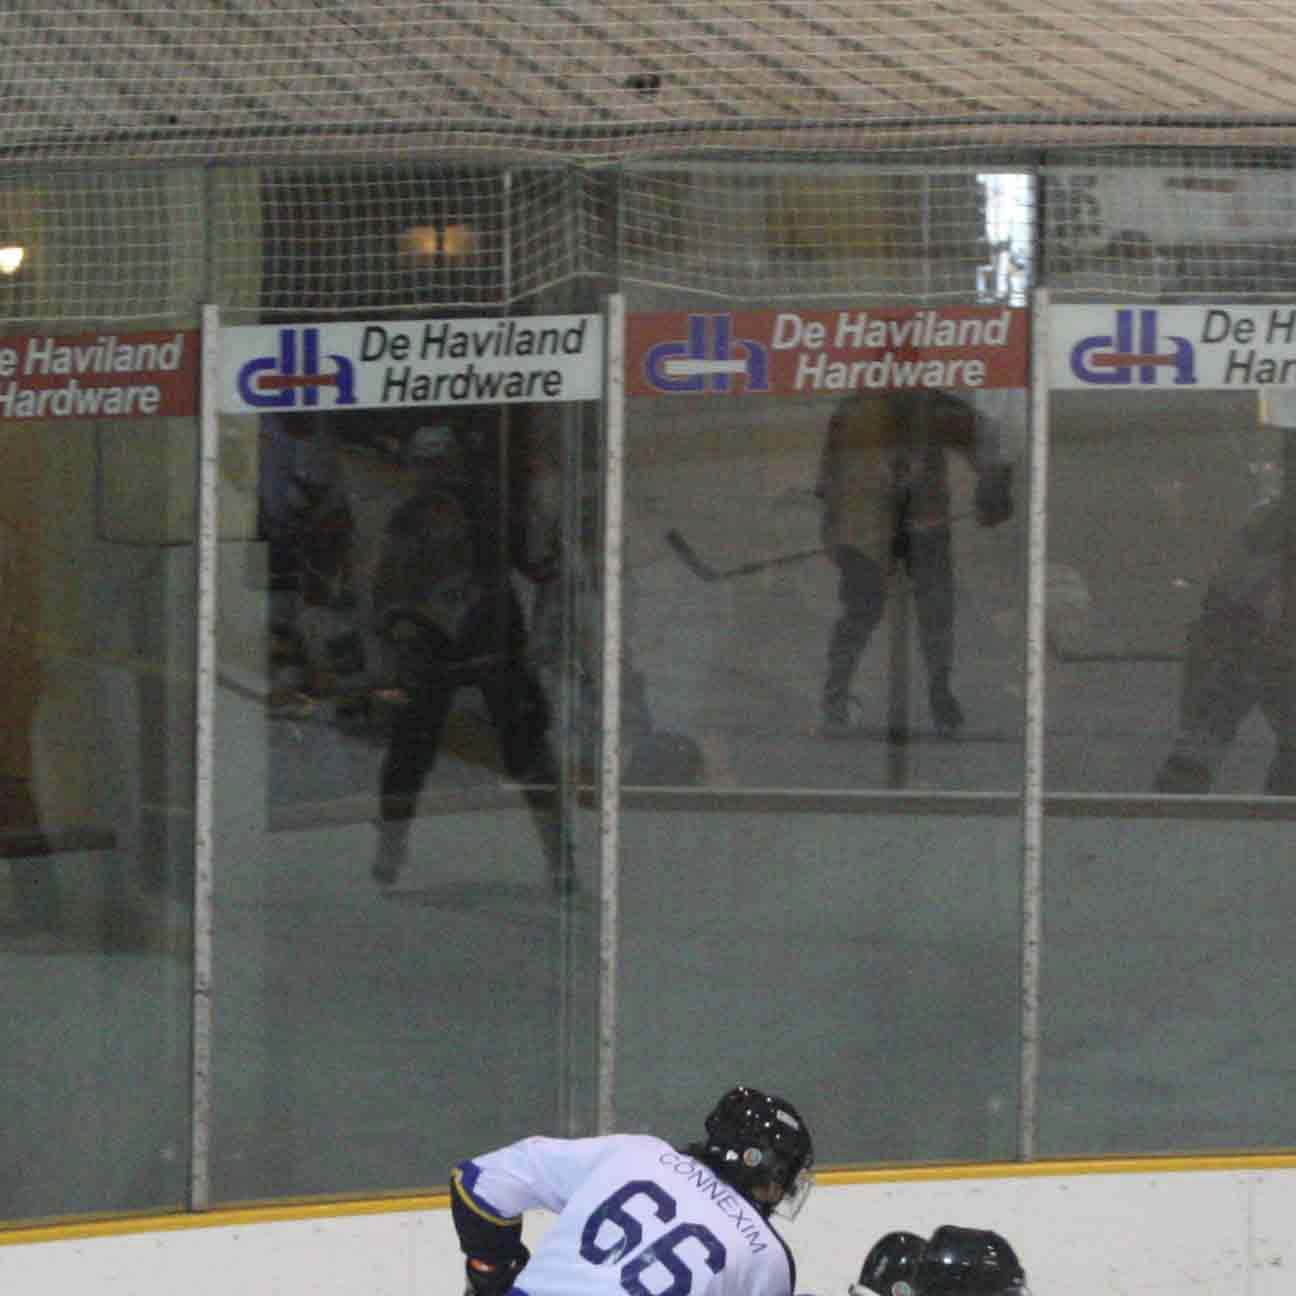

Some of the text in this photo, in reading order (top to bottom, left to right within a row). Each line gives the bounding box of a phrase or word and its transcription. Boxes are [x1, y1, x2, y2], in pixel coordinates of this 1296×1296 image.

[359, 318, 585, 362] De Haviland
[772, 310, 1010, 350] De Haviland
[1200, 307, 1255, 345] De
[24, 334, 183, 376] Haviland
[793, 353, 986, 391] Hardware
[380, 364, 563, 402] Hardware
[659, 1152, 768, 1254] CONNEXIM
